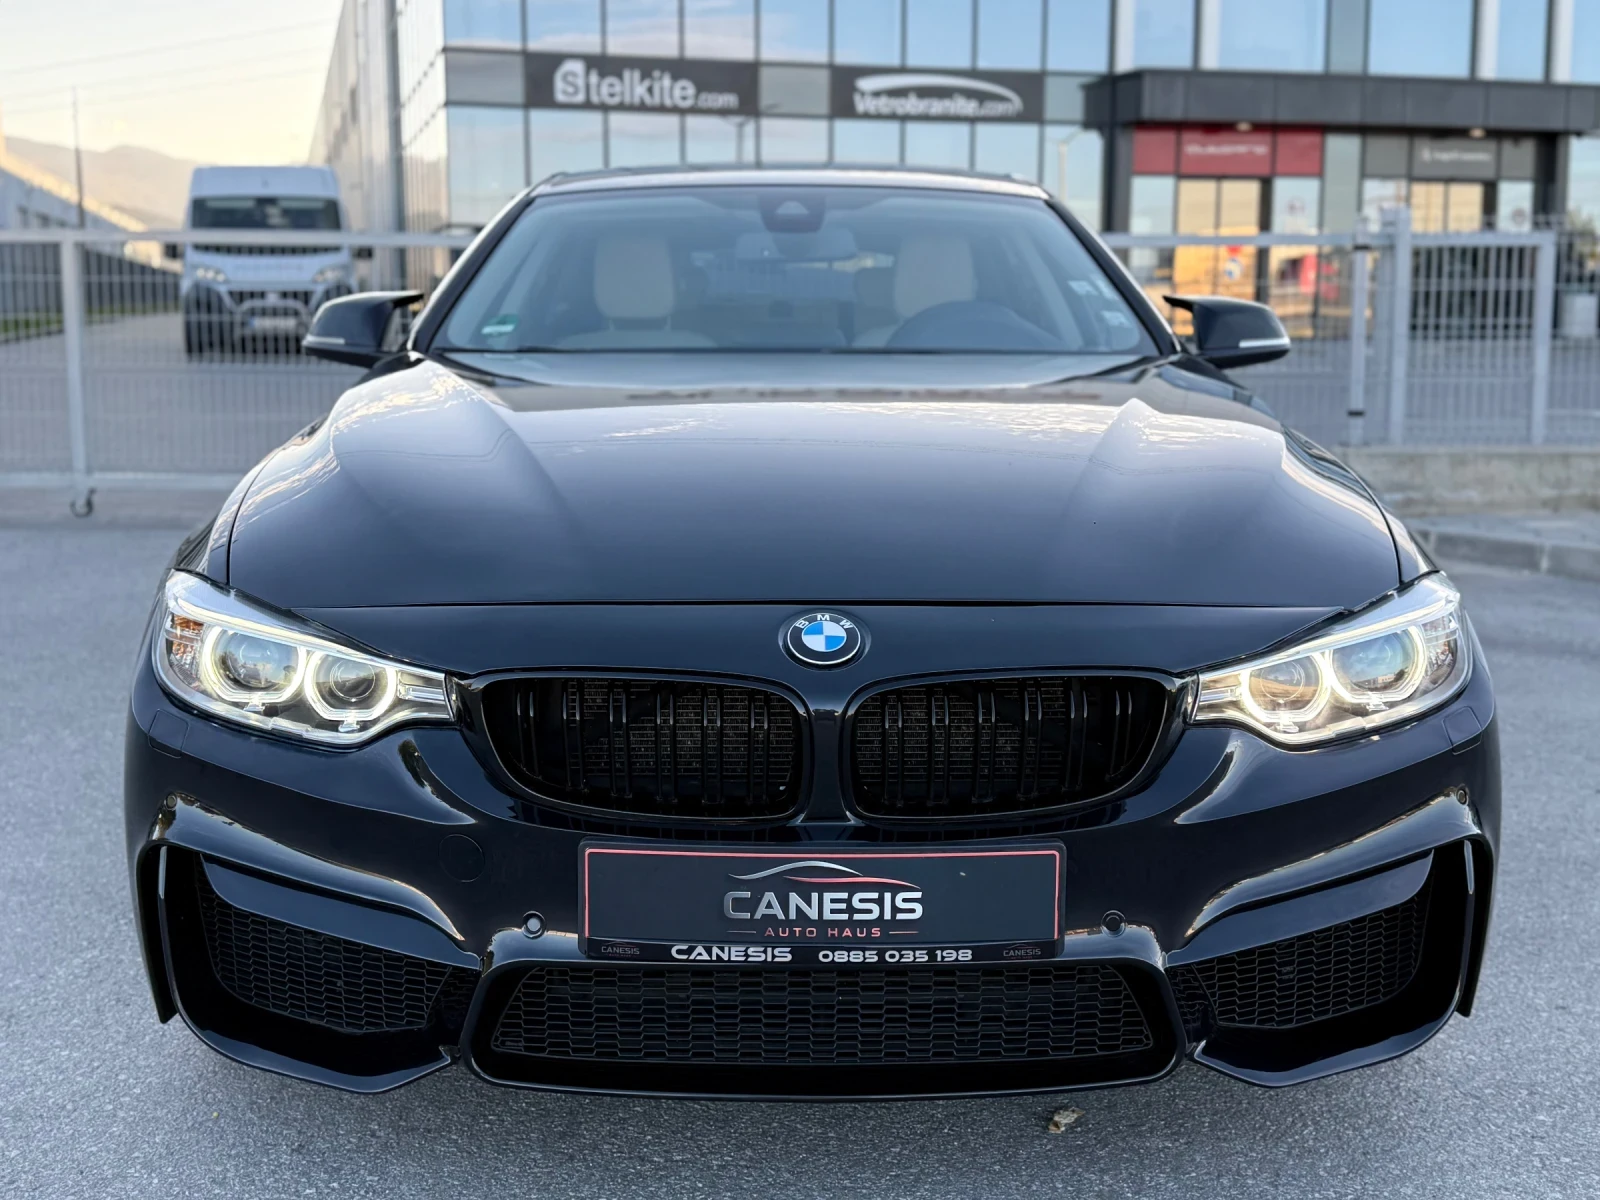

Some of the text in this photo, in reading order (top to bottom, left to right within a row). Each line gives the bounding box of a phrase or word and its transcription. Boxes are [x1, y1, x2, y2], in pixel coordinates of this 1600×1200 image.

[554, 58, 740, 109] Stelkite.com
[795, 614, 854, 629] BMW
[723, 891, 924, 920] CANESIS
[764, 927, 881, 937] AUTO HAUS
[601, 946, 640, 955] CANESIS
[671, 945, 973, 963] CANESIS 0885 035 198
[1003, 948, 1042, 957] CANESIS
